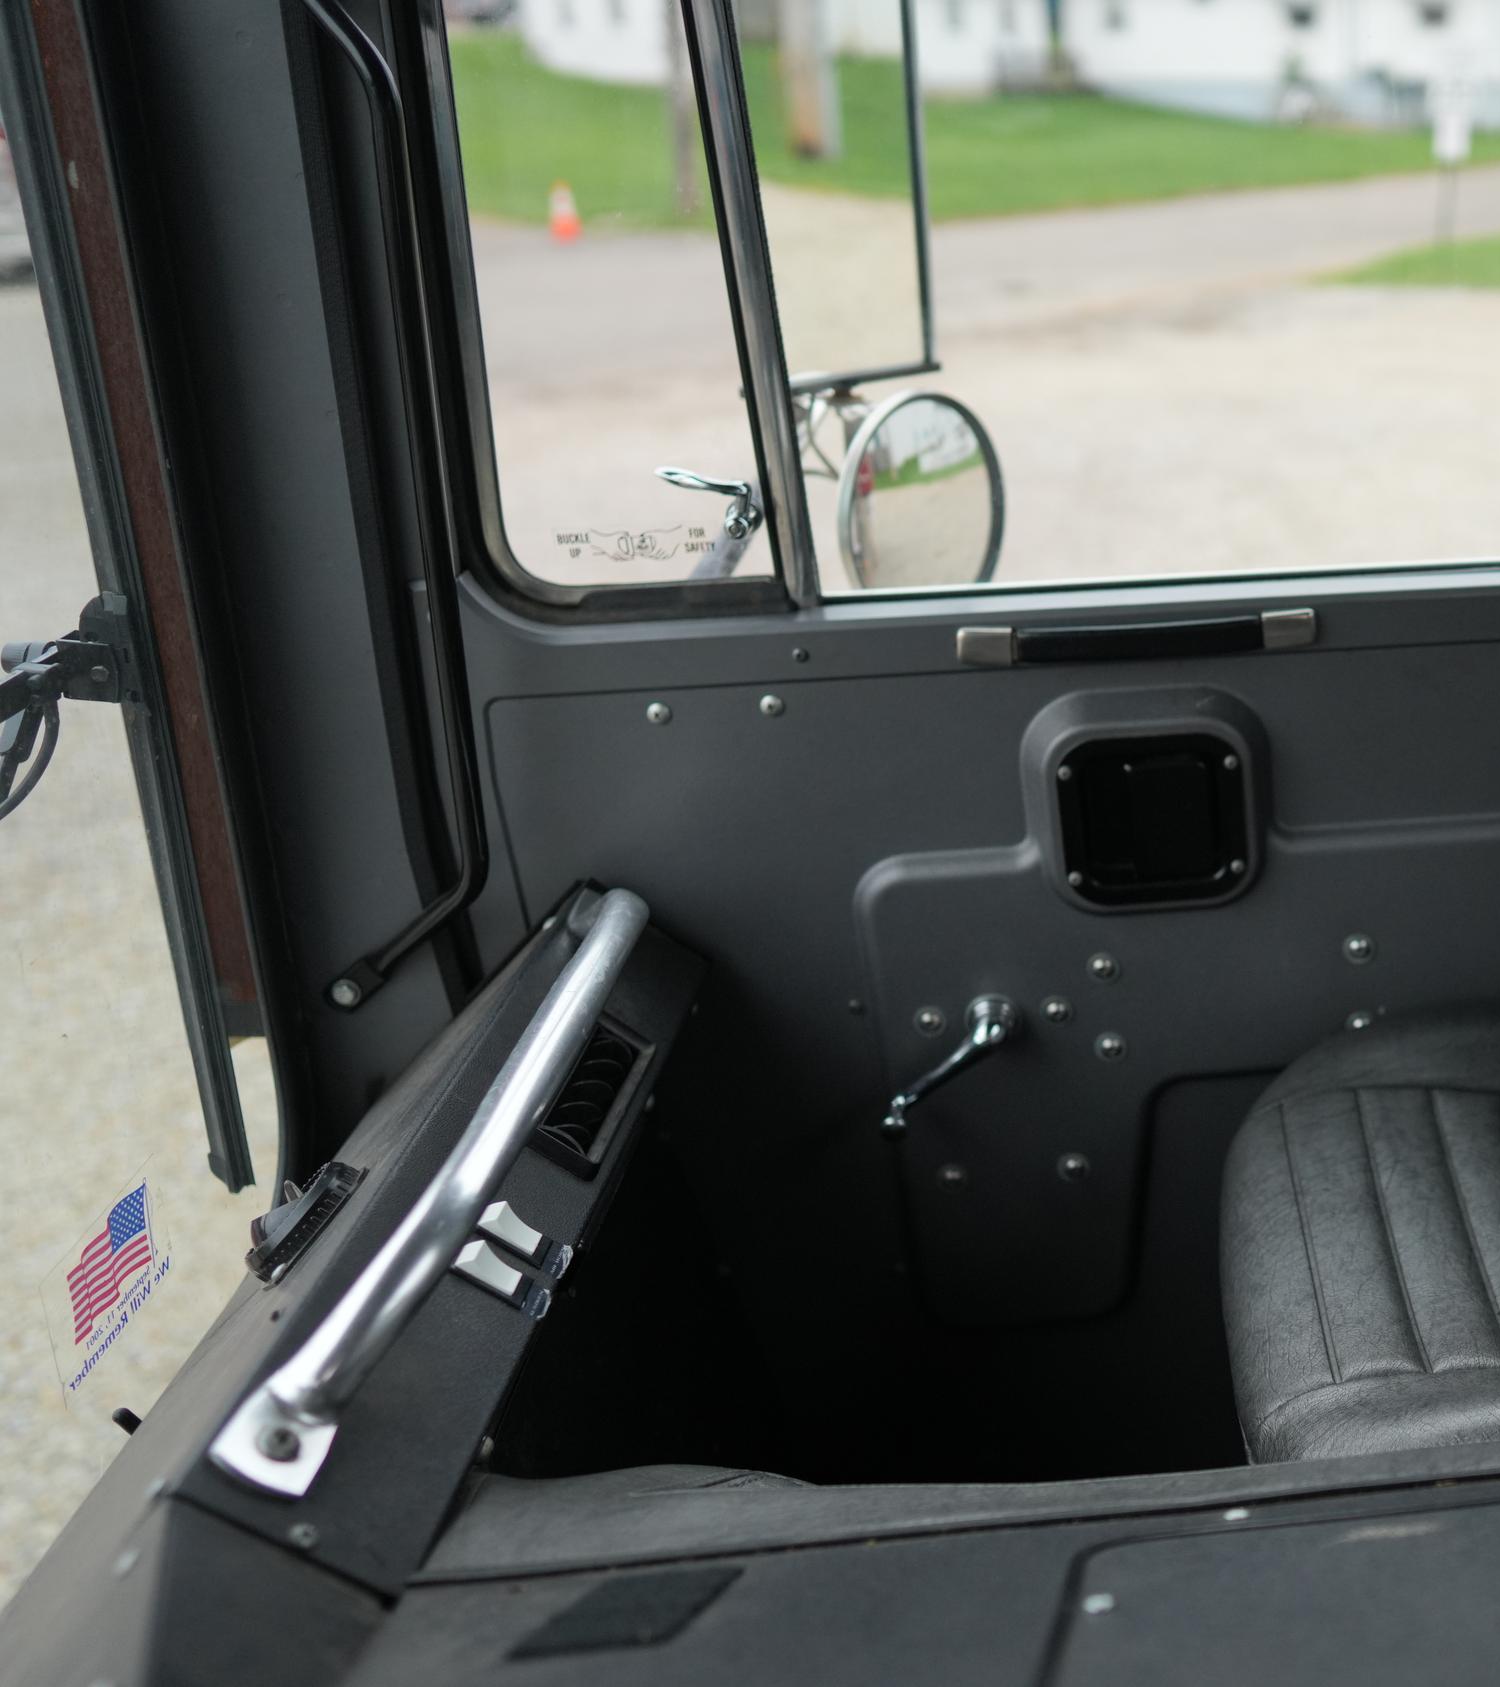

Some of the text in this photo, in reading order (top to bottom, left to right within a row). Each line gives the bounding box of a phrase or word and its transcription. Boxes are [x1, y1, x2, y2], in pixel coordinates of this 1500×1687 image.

[556, 533, 591, 545] BUCKLE
[688, 528, 705, 539] FOR
[684, 541, 715, 553] SAFETY
[569, 548, 581, 558] UP
